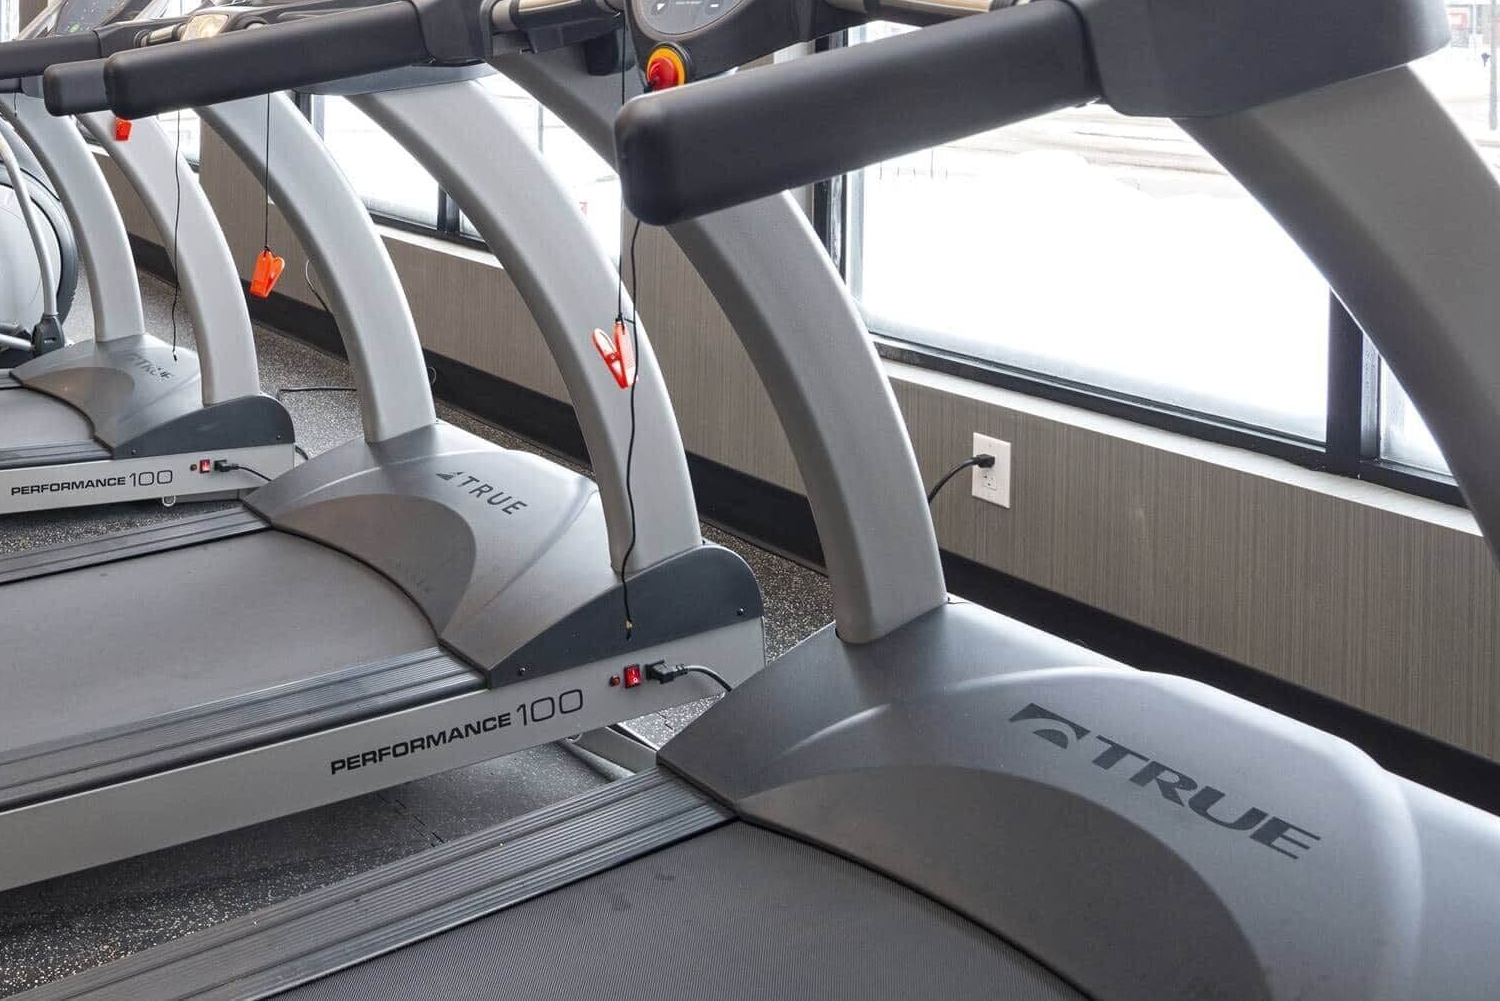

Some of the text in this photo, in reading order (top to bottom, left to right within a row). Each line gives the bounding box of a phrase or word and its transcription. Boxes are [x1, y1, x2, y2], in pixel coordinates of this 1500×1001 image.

[11, 469, 174, 496] PERFORMANCE 100
[457, 475, 528, 515] TRUE
[330, 688, 584, 776] PERFORMANCE 100
[1090, 734, 1322, 860] TRUE
